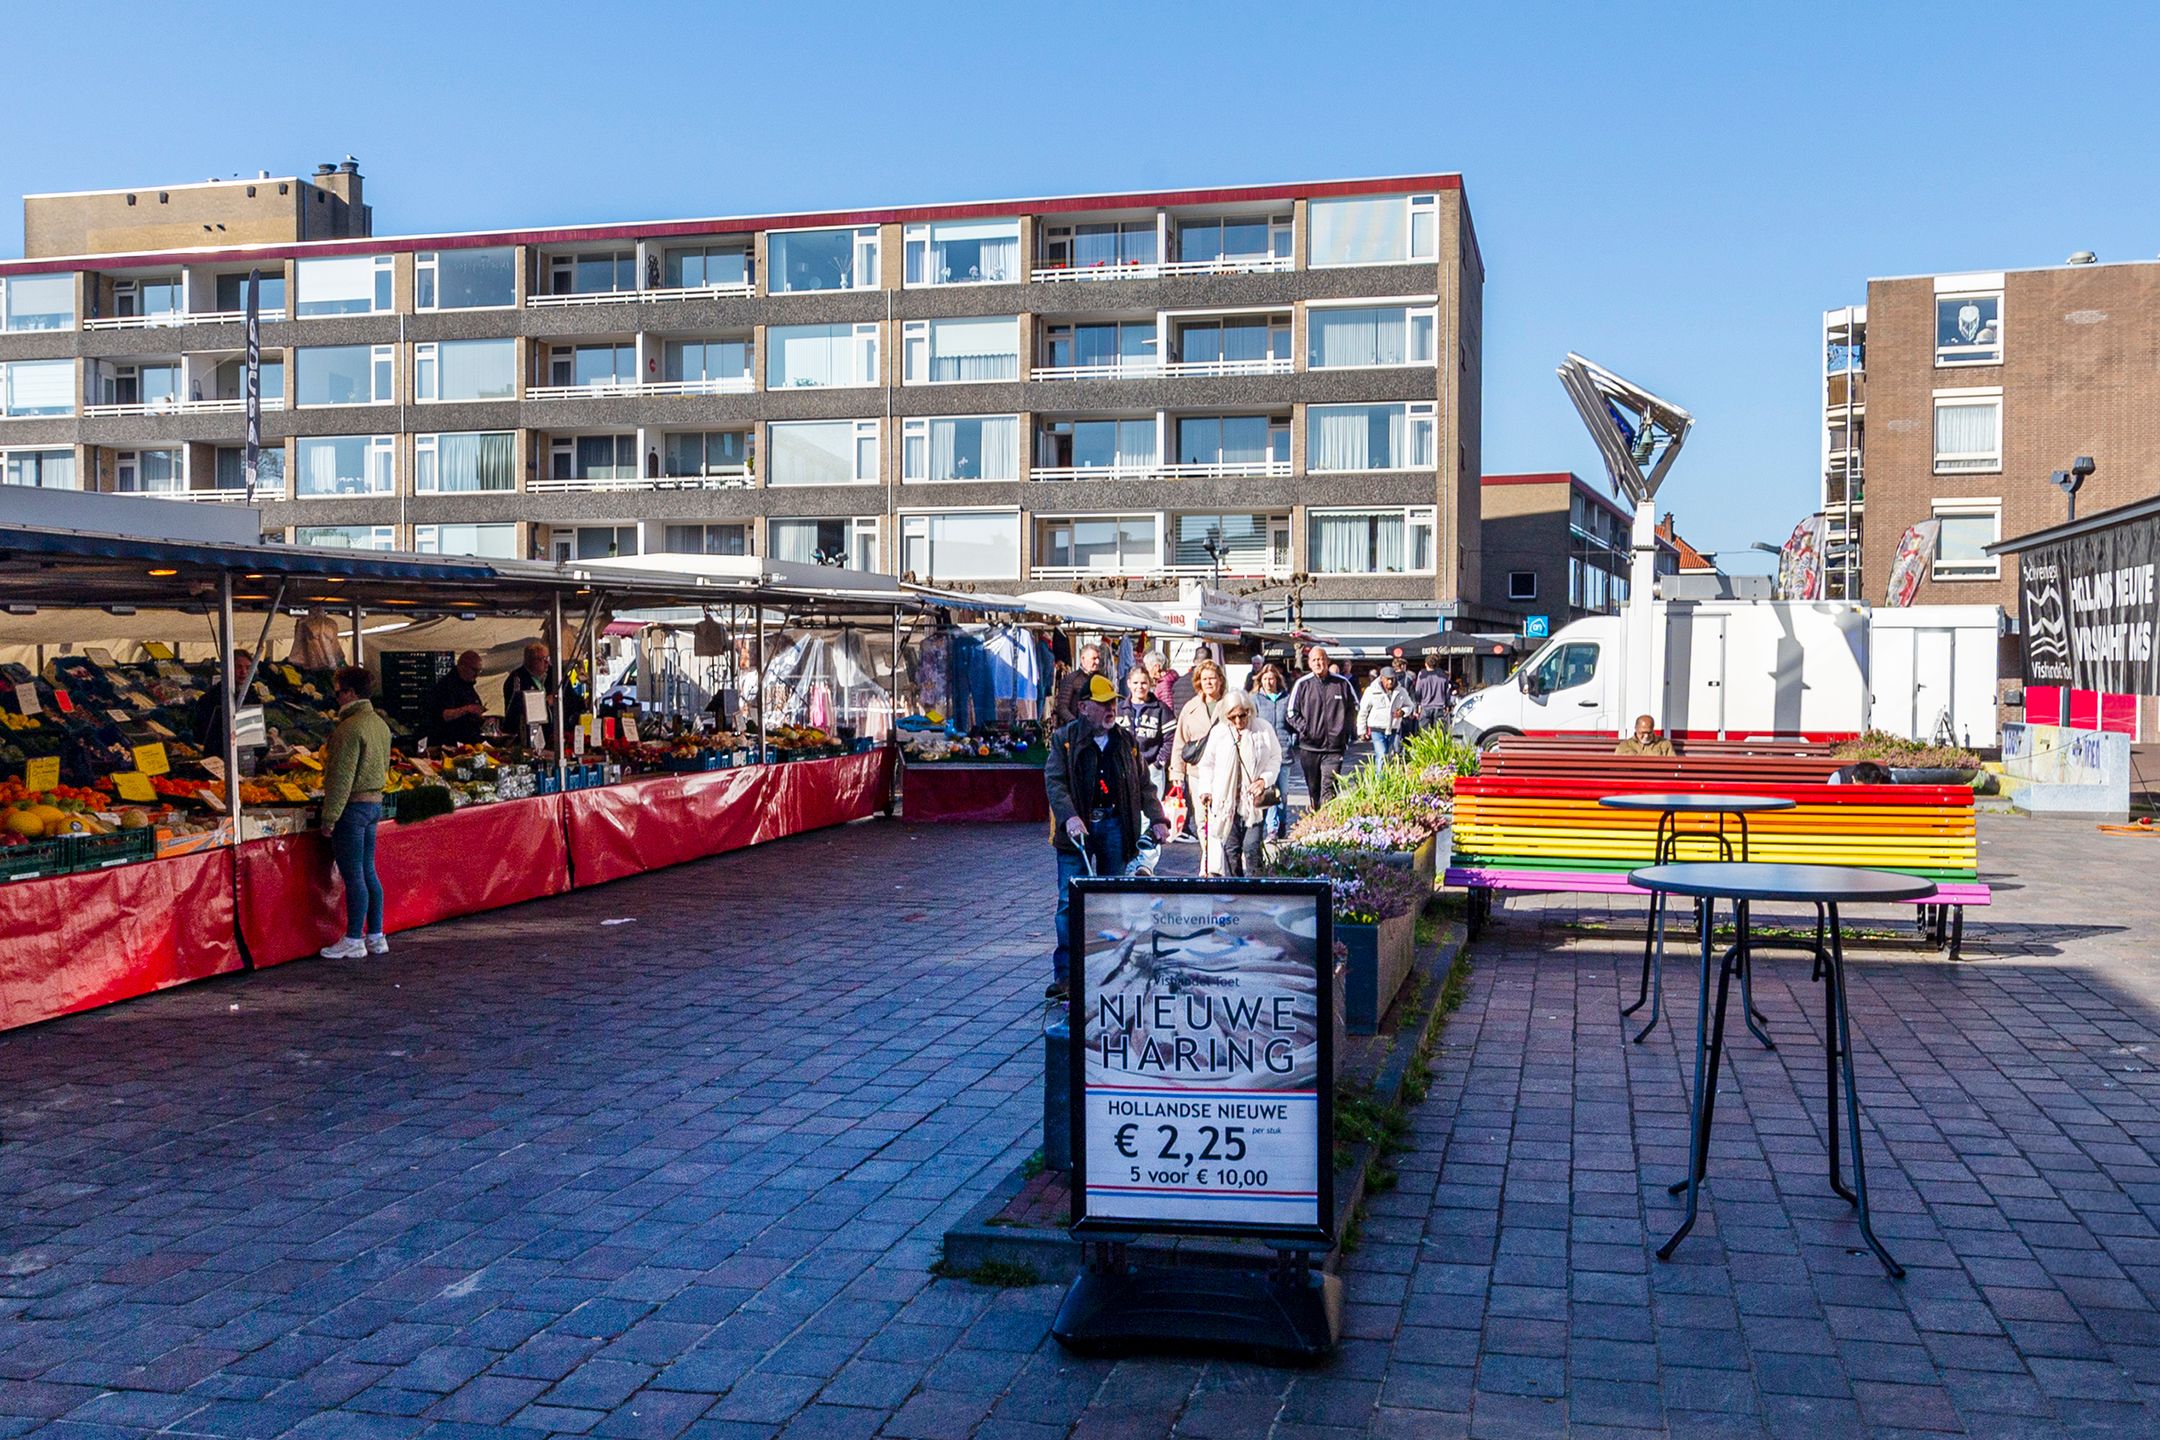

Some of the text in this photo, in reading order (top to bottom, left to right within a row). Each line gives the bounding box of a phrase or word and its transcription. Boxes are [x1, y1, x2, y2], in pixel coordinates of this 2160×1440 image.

[1152, 913, 1240, 927] Scheveningse
[1153, 974, 1240, 988] Vishandel Toet
[1099, 993, 1297, 1032] NIEUWE
[1101, 1034, 1295, 1075] HARING
[1108, 1100, 1287, 1120] HOLLANDSE NIEUWE
[1252, 1126, 1282, 1135] per stuk
[1114, 1123, 1247, 1167] € 2,25
[1130, 1166, 1268, 1188] 5 voor € 10,00
